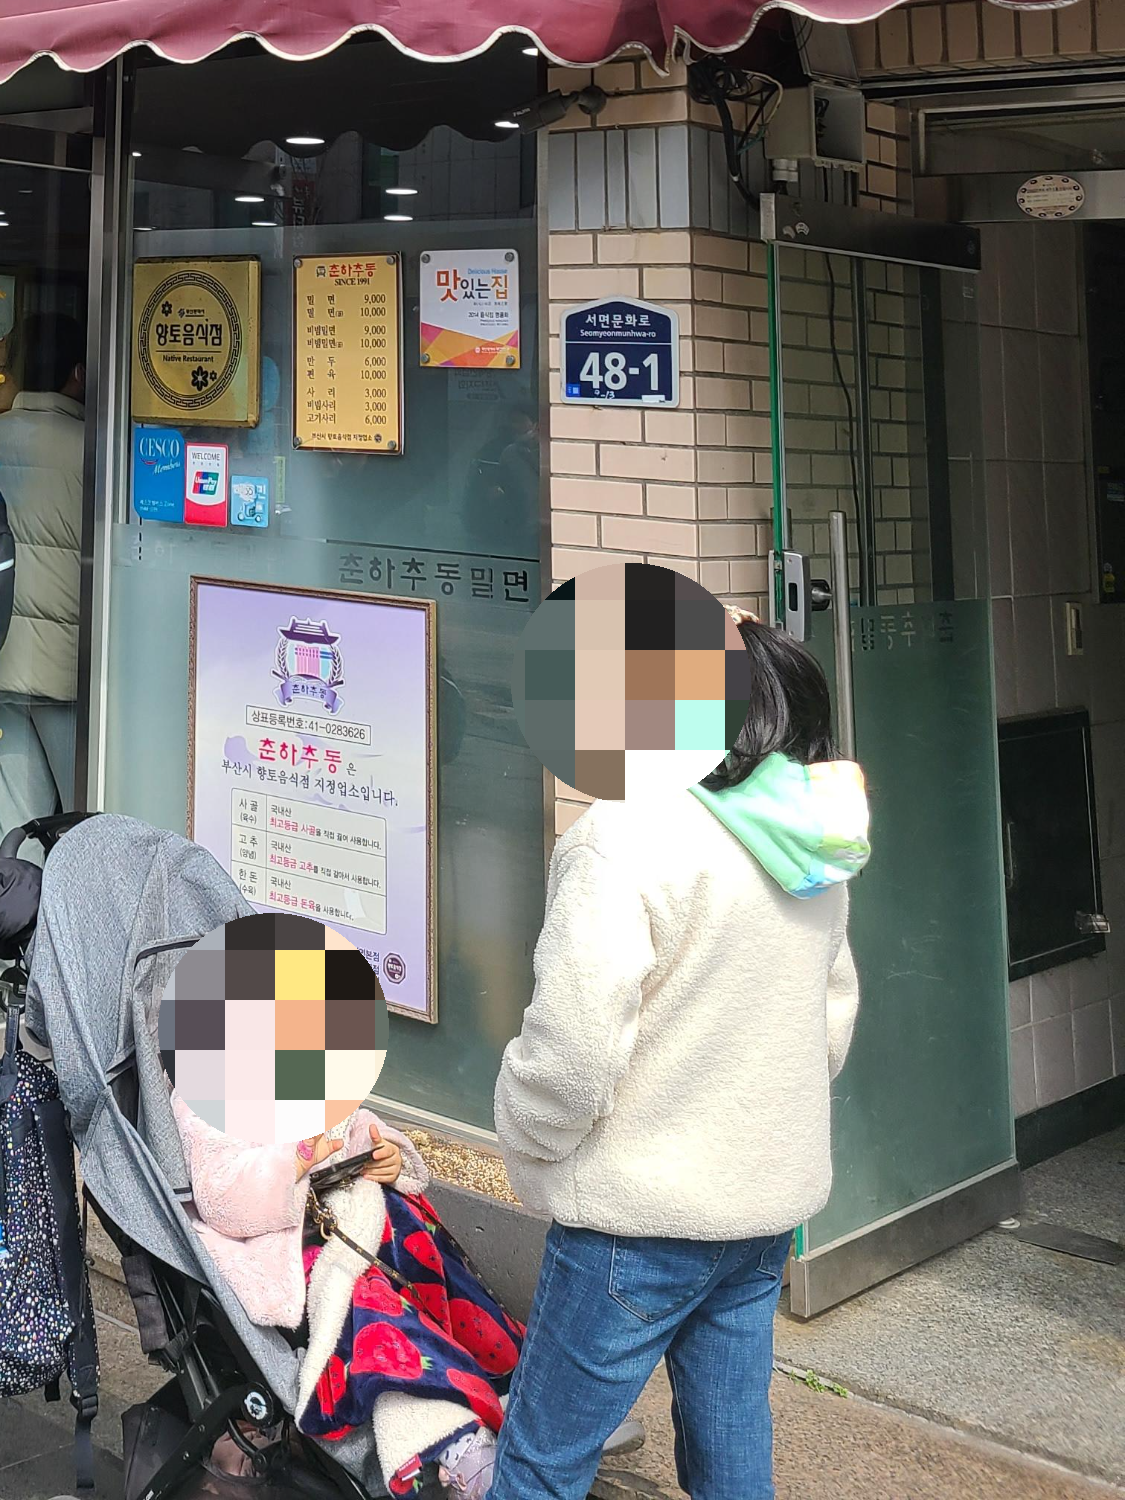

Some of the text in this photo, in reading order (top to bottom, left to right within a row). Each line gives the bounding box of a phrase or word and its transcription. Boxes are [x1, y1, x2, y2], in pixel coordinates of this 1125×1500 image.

[329, 263, 376, 277] 춘하추동
[335, 278, 370, 286] SINCE 1991
[437, 269, 508, 302] 맛있는집
[364, 294, 386, 304] 9,000
[360, 307, 386, 317] 10,000
[586, 313, 651, 329] 서면문화로
[156, 320, 222, 346] 향토음식점
[307, 325, 386, 336] 비빔밀면 9,000
[580, 329, 656, 338] Seomyeonmunhwa-ro
[360, 338, 386, 349] 10,000
[163, 355, 214, 363] Native Restaurant
[364, 357, 386, 367] 6,000
[361, 370, 387, 380] 10,000
[579, 351, 659, 391] 48-1
[365, 388, 387, 399] 3,000
[307, 400, 387, 412] 비빔사리 3,000
[307, 413, 387, 426] 고기사리 6,000
[139, 437, 180, 459] CESCO
[192, 452, 221, 461] WELCOME
[153, 459, 181, 474] Members
[292, 684, 327, 698] 춘하추동
[259, 738, 342, 774] 춘하추동
[222, 759, 398, 806] 부산시 향토음식점 지정업소입니다.
[270, 804, 292, 817] 국내산
[240, 811, 257, 824] (육수)
[270, 817, 299, 832] 최고등급
[270, 840, 292, 853] 국내산
[270, 853, 297, 869] 최고등급
[270, 876, 292, 890] 국내산
[269, 890, 298, 907] 최고등급
